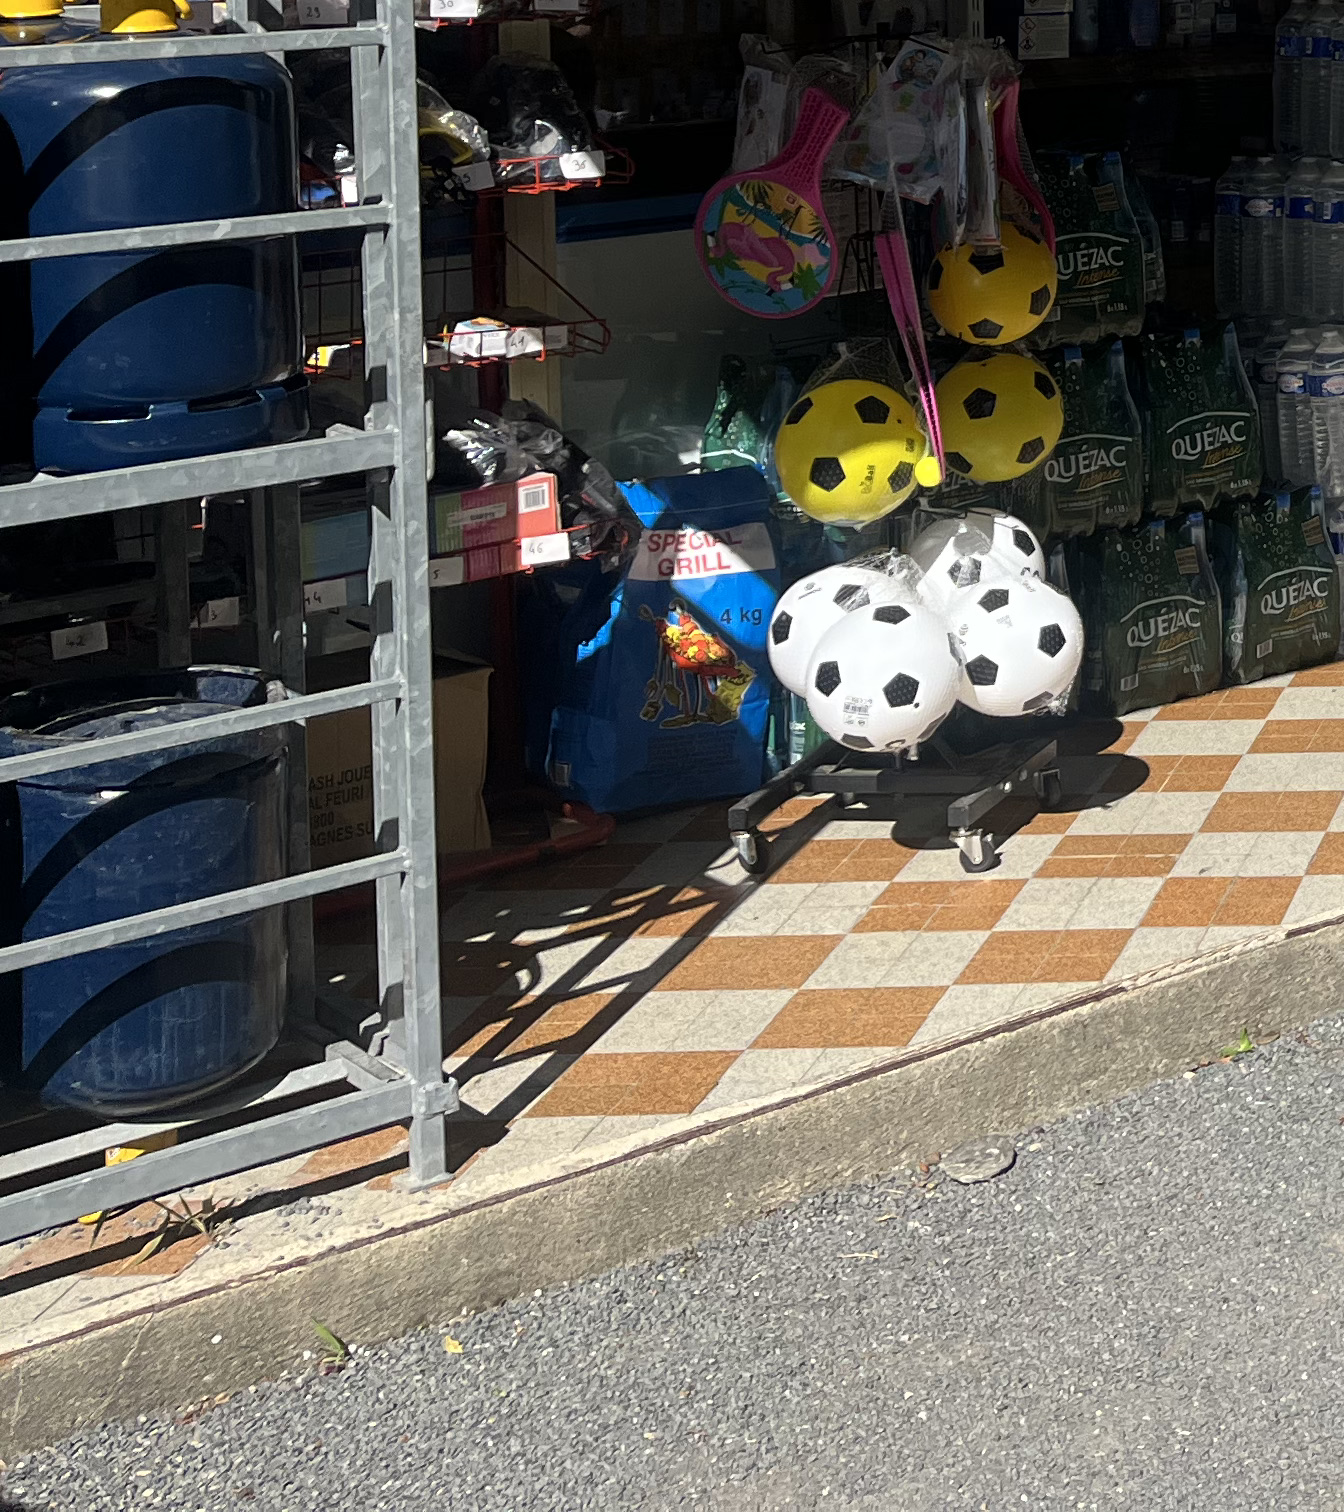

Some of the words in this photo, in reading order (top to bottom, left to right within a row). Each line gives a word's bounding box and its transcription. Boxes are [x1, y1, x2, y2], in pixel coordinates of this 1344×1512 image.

[1057, 243, 1125, 281] UÉZAC
[1172, 420, 1246, 461] QUÉZAC
[1044, 444, 1127, 483] QUÉZAC
[647, 532, 743, 554] SPECIAL
[658, 552, 731, 577] GRILL
[1261, 576, 1329, 615] QUÉZAC
[720, 607, 732, 624] 4
[740, 606, 763, 626] kg
[1126, 606, 1201, 648] QUÉZAC
